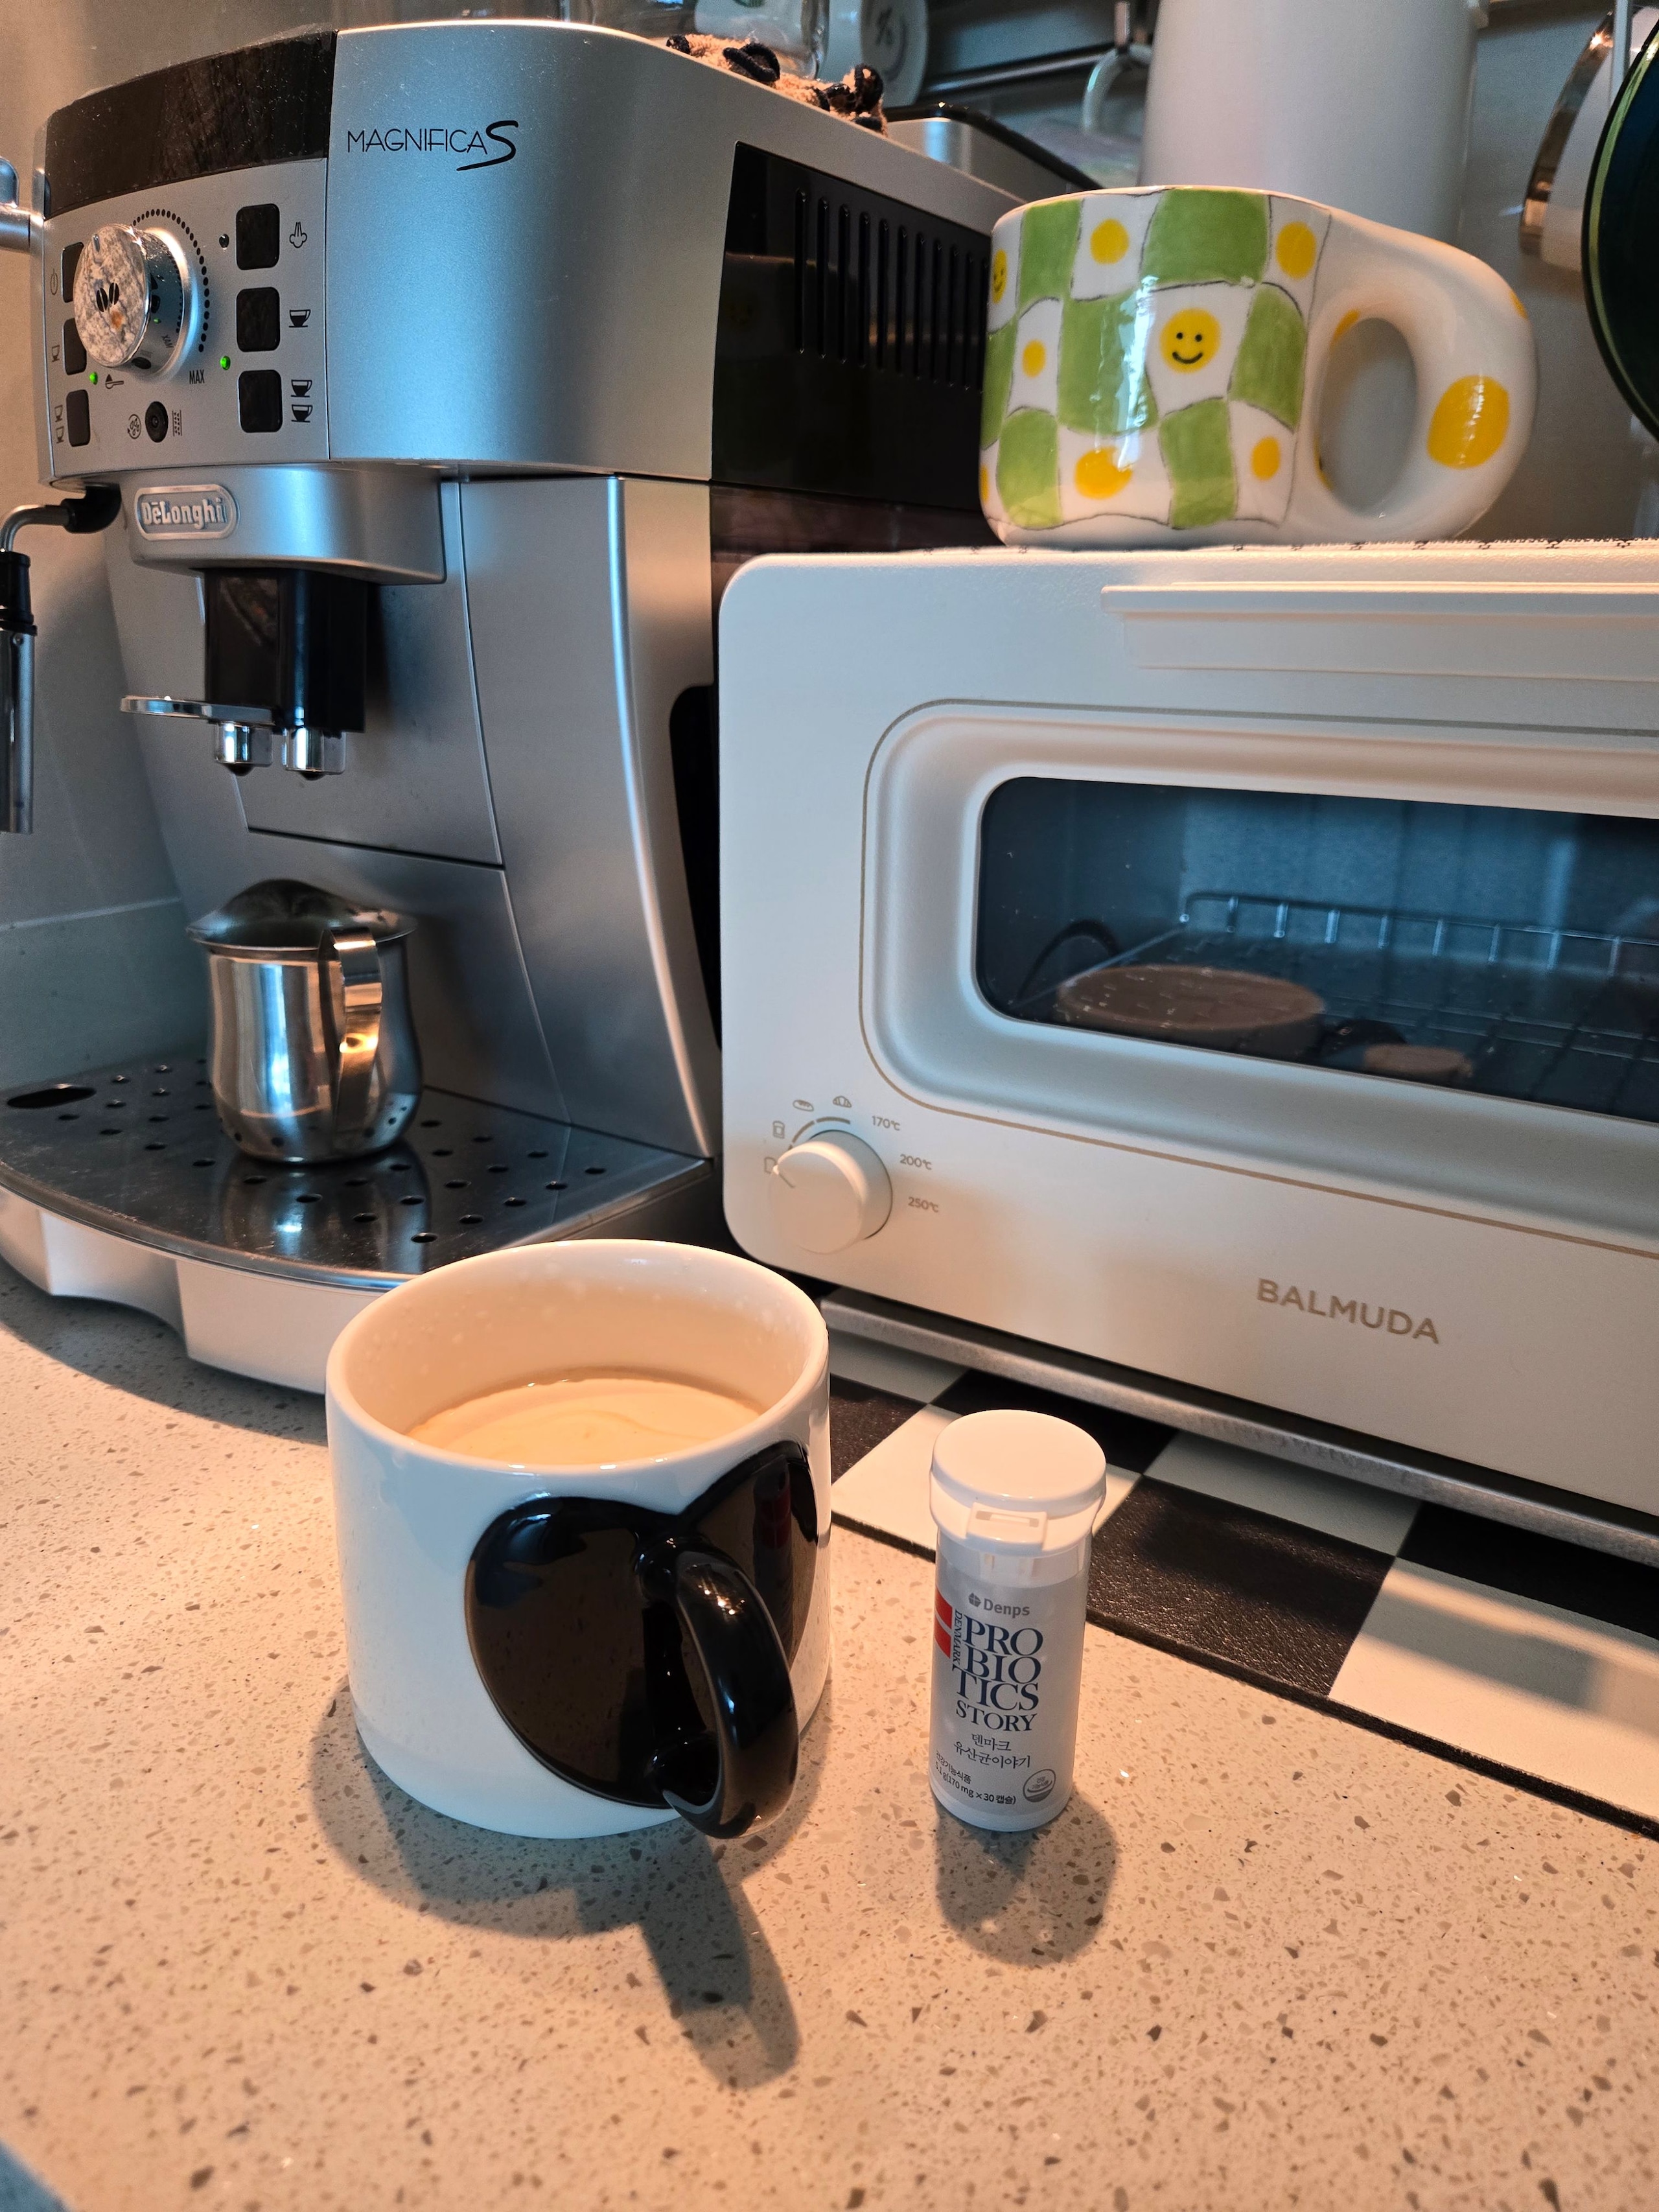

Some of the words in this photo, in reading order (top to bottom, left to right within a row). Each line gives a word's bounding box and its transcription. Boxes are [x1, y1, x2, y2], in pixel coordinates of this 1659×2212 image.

[347, 128, 488, 154] MAGNIFICA
[456, 120, 518, 171] S
[189, 369, 205, 384] MAX
[1257, 1278, 1439, 1344] BALMUDA
[983, 1598, 1030, 1619] Denps
[952, 1609, 963, 1666] DENMARK
[962, 1614, 1044, 1657] PRO
[963, 1644, 1041, 1684] BIO
[952, 1663, 1039, 1712] TICS
[956, 1699, 1038, 1732] STORY
[953, 1741, 1030, 1769] 유산균이야기
[972, 1733, 1012, 1751] 덴마크
[961, 1786, 974, 1798] mg
